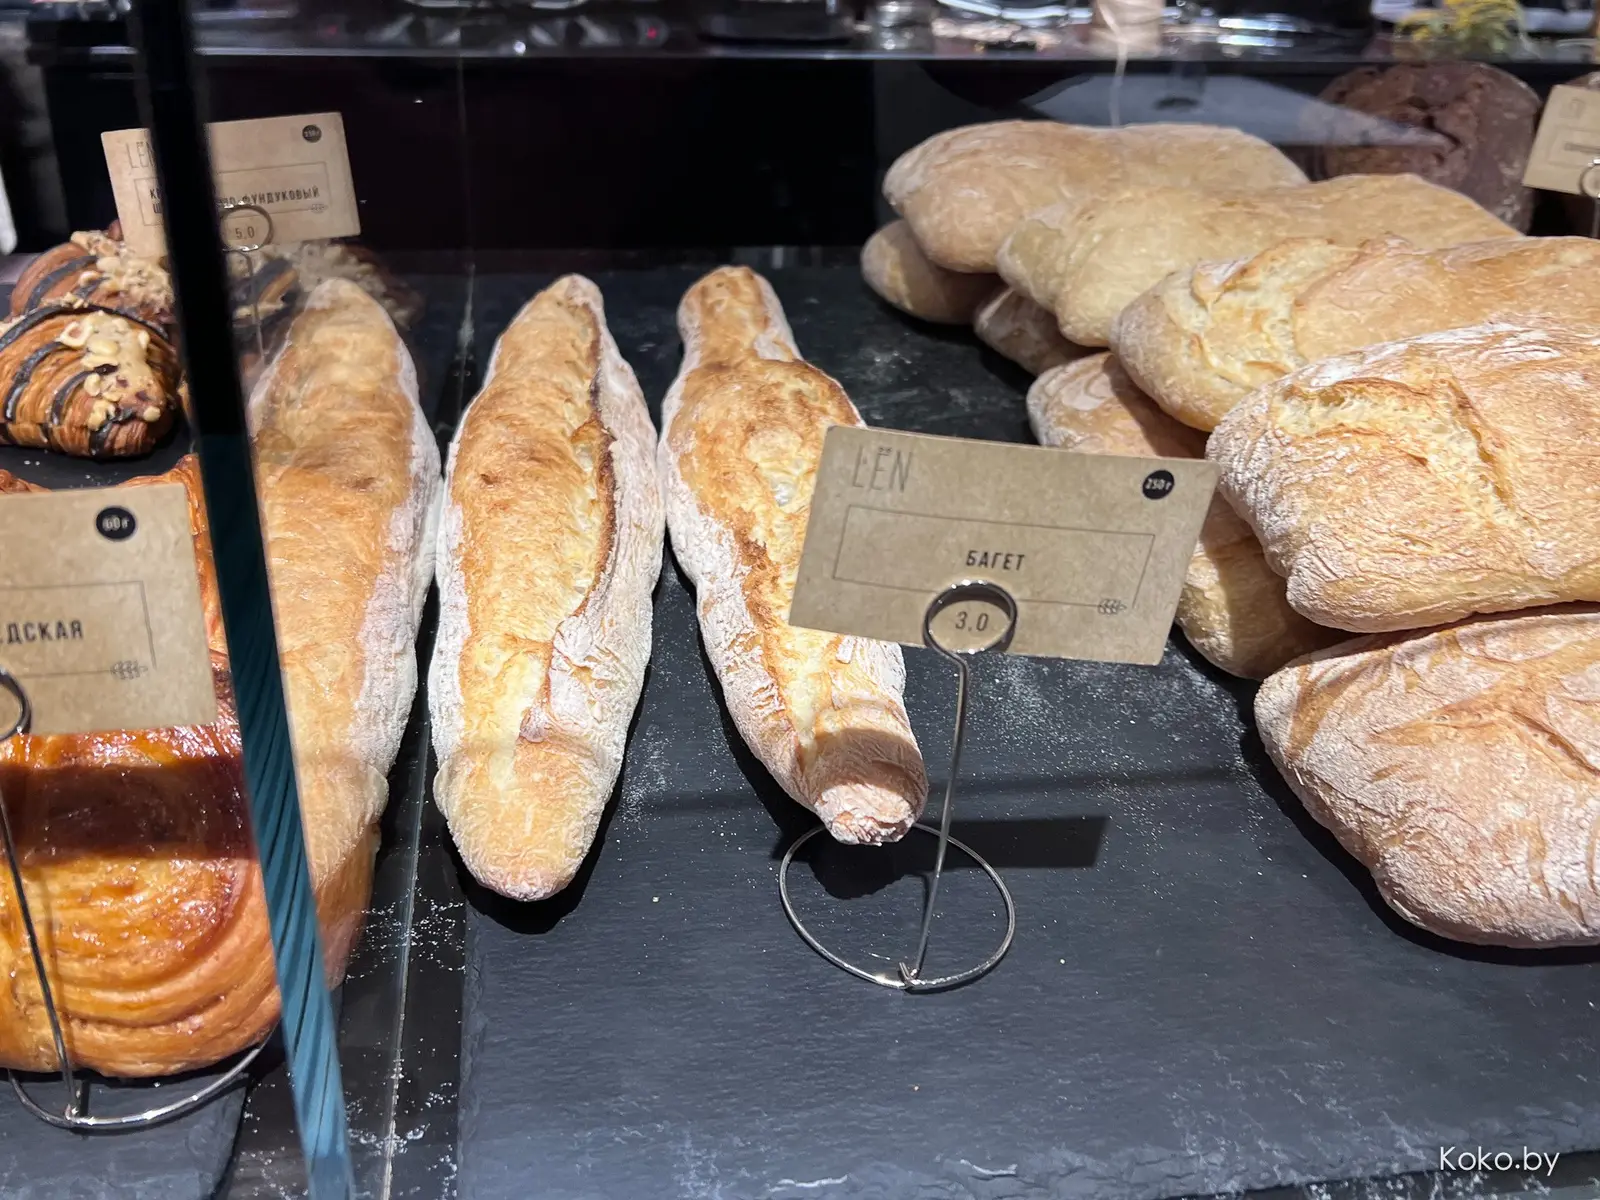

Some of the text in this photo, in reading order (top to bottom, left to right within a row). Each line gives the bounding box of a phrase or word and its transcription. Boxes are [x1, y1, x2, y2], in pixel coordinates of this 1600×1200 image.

[966, 549, 1025, 571] БАГЕТ
[0, 619, 83, 645] ДСКАЯ
[955, 611, 989, 632] 3.0
